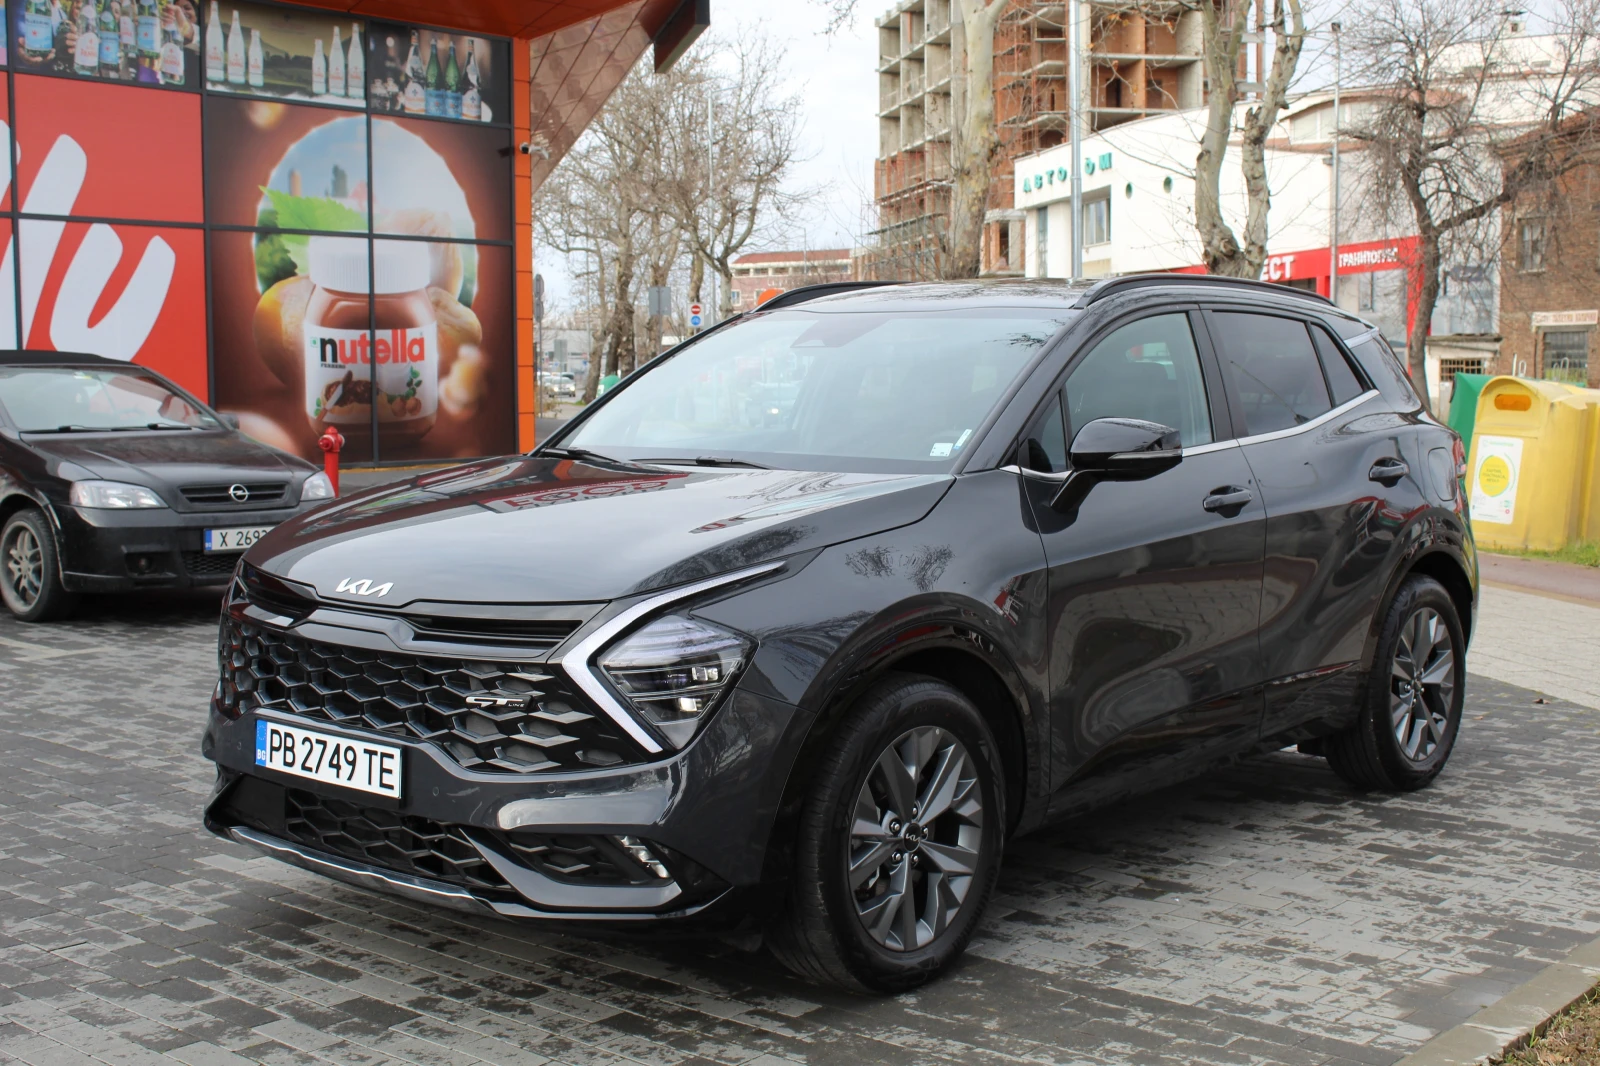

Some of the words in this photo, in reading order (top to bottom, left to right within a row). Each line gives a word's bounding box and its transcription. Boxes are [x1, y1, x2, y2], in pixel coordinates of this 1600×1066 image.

[320, 328, 425, 365] nutella
[335, 577, 394, 598] KIA
[257, 748, 266, 760] BG
[265, 728, 296, 768] PB
[301, 736, 357, 782] 2749
[363, 748, 395, 790] TE
